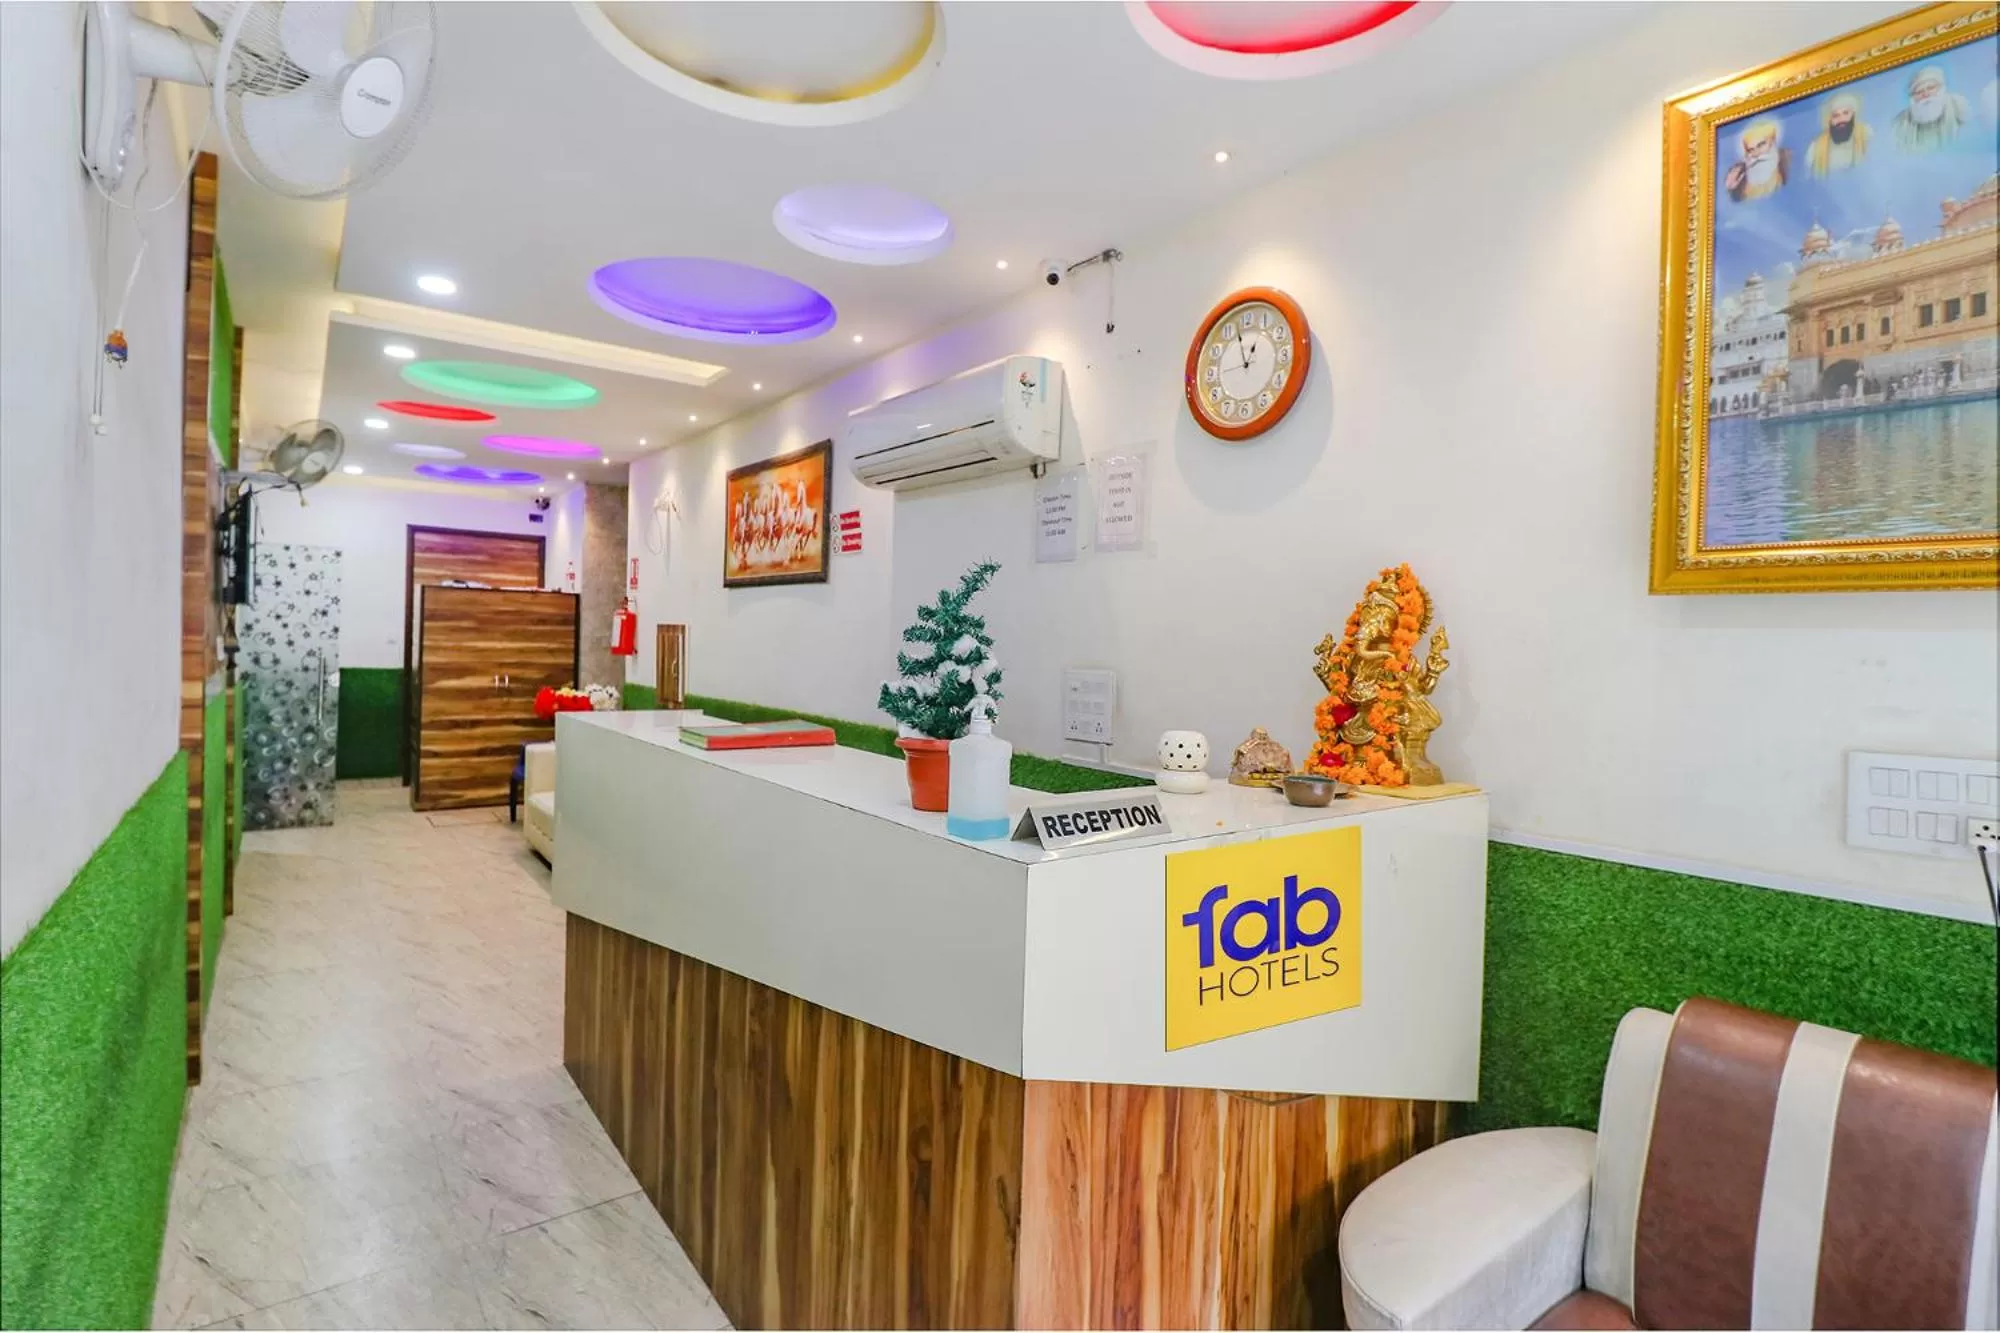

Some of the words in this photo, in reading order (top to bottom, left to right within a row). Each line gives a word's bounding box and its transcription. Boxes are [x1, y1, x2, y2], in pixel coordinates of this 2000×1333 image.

[1241, 313, 1252, 326] 12
[1224, 326, 1232, 338] 11
[1275, 326, 1284, 340] 2
[1280, 348, 1289, 361] 3
[1207, 368, 1214, 381] 9
[1274, 374, 1282, 387] 4
[1260, 393, 1268, 408] 5
[1224, 402, 1230, 414] 7
[1241, 403, 1249, 416] 6
[1042, 804, 1162, 838] RECEPTION
[1183, 875, 1341, 969] fab
[1199, 947, 1340, 1006] HOTELS
